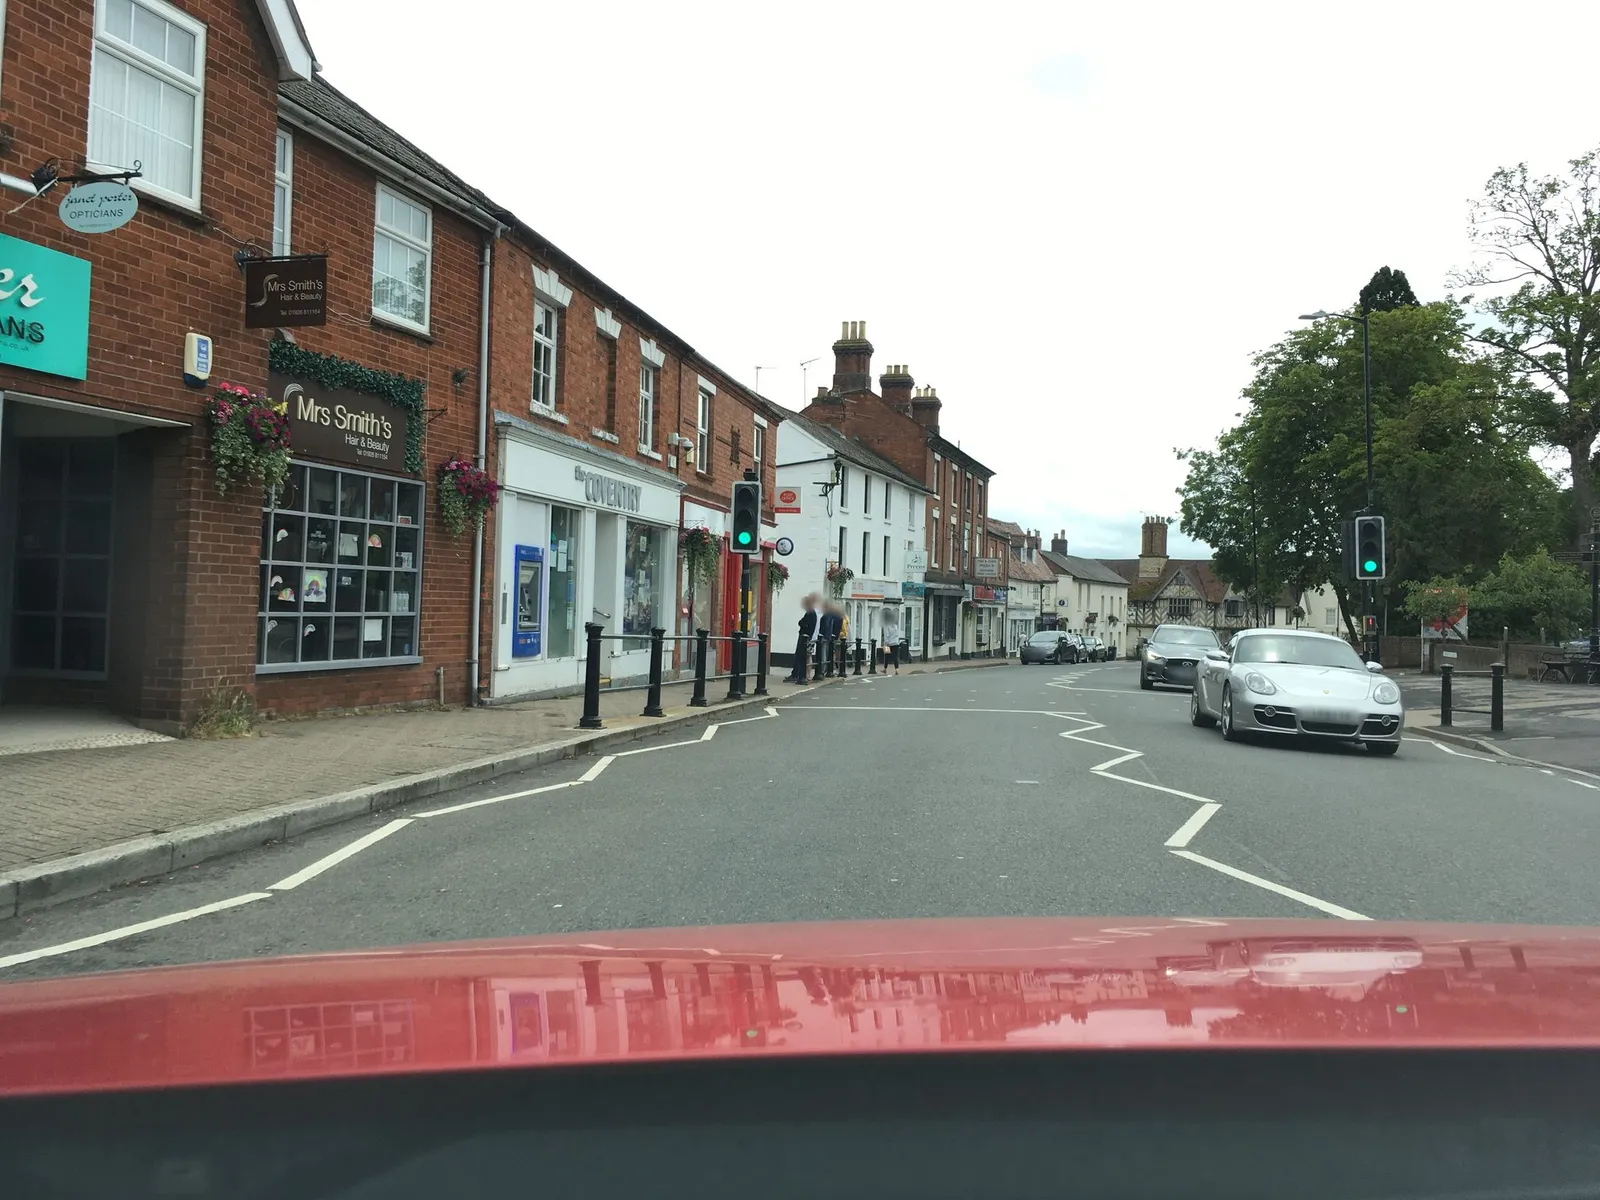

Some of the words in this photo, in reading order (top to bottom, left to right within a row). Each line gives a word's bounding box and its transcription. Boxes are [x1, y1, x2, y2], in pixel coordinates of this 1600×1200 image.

[69, 209, 124, 220] OPTICIANS
[268, 281, 286, 292] Mrs
[288, 279, 323, 292] Smith's
[294, 293, 299, 301] &
[300, 292, 322, 301] Beauty
[297, 395, 331, 426] Mrs
[334, 404, 392, 440] Smith's
[344, 433, 360, 447] Hair
[360, 436, 366, 448] &
[367, 437, 390, 454] Beauty
[585, 471, 642, 513] COVENTRY
